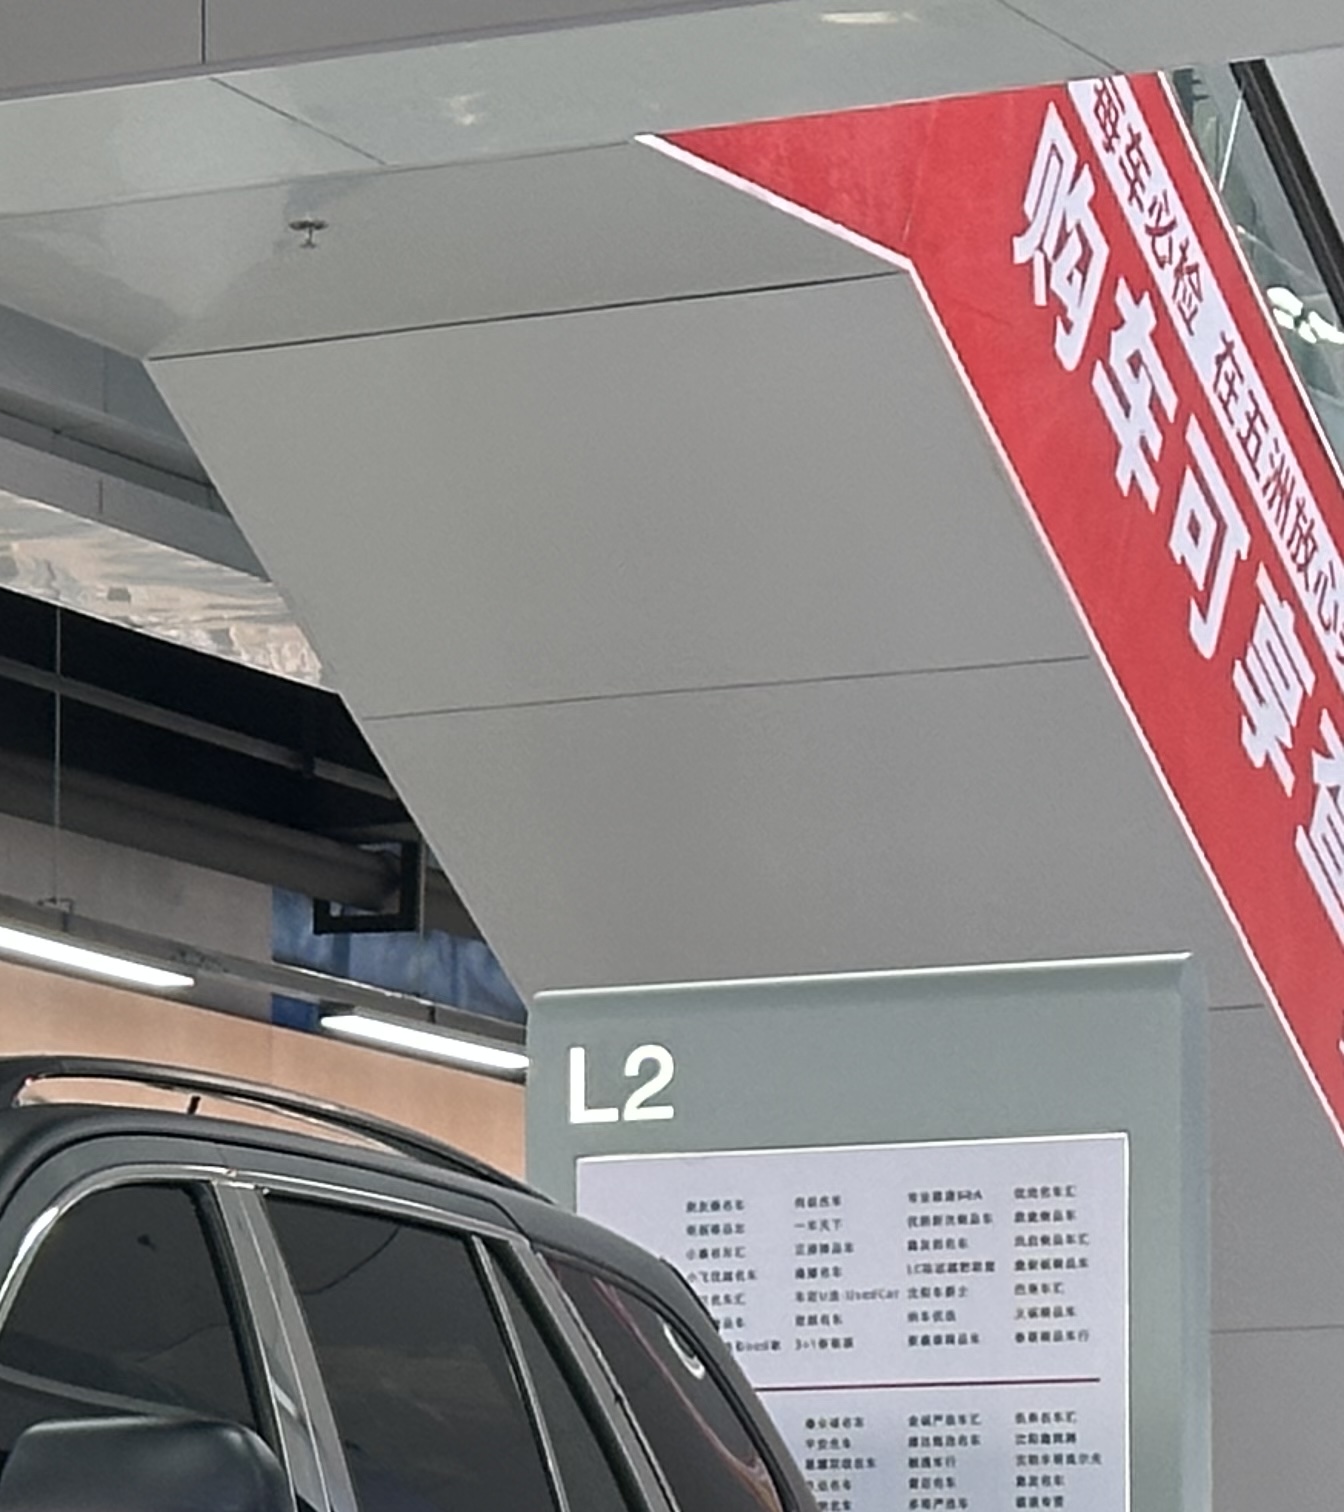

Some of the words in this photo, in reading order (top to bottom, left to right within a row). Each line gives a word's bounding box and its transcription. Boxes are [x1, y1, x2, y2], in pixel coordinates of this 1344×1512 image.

[1212, 329, 1344, 666] 在五洲放心
[568, 1044, 675, 1125] L2
